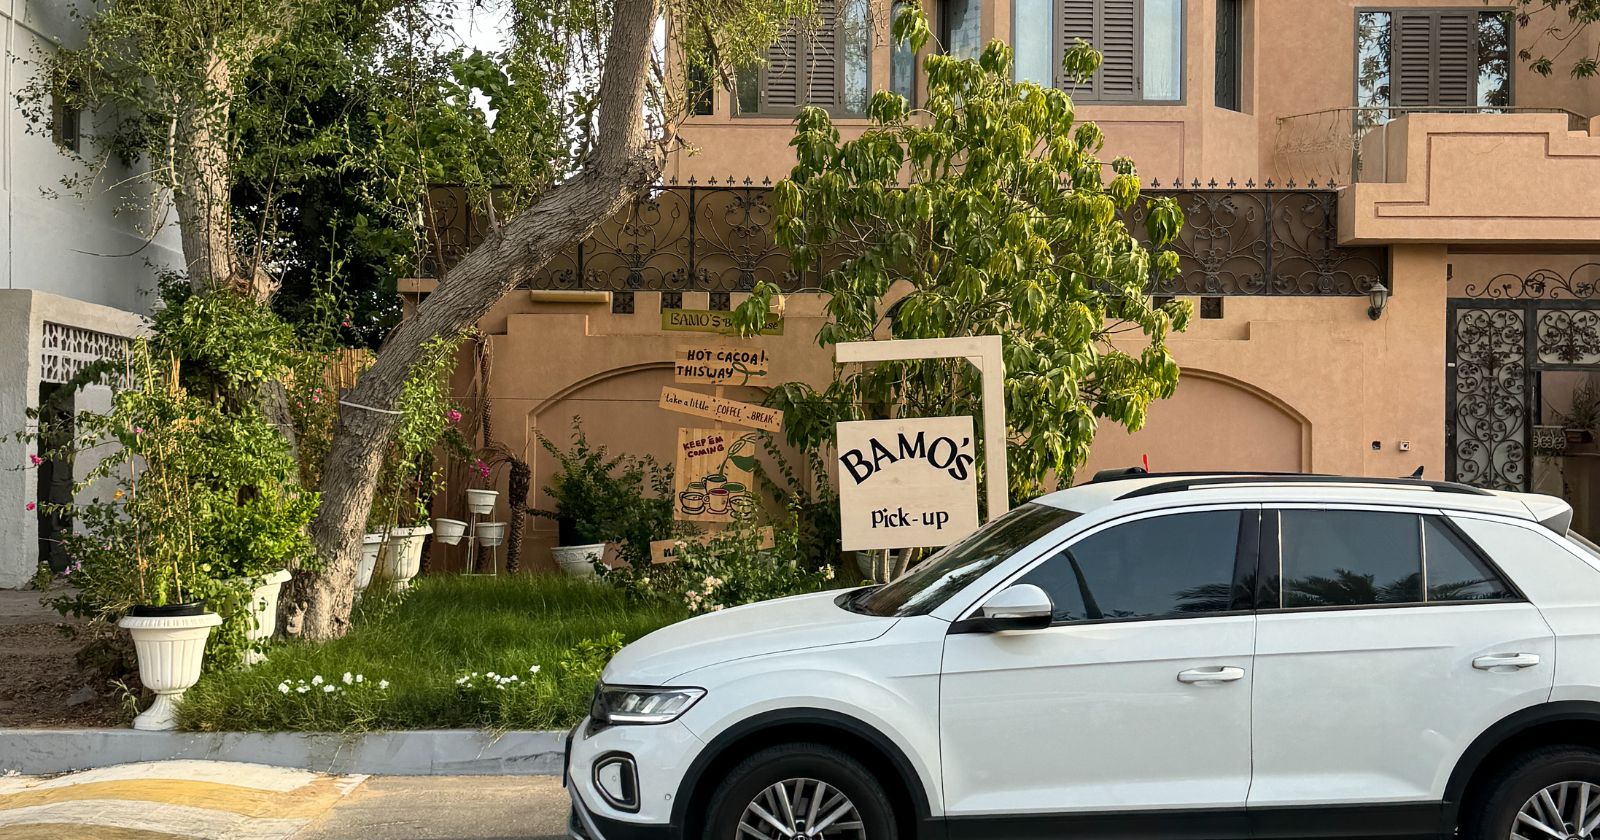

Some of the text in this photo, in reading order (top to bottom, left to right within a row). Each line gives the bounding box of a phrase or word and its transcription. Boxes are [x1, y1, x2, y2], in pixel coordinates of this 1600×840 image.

[671, 312, 721, 327] BAMO'S
[687, 349, 765, 366] HOT CACOA!
[665, 393, 682, 405] take
[690, 398, 709, 411] little
[716, 404, 742, 418] COFFEE
[750, 411, 775, 424] BREAK
[682, 438, 707, 451] KEEP
[687, 444, 725, 458] COMING
